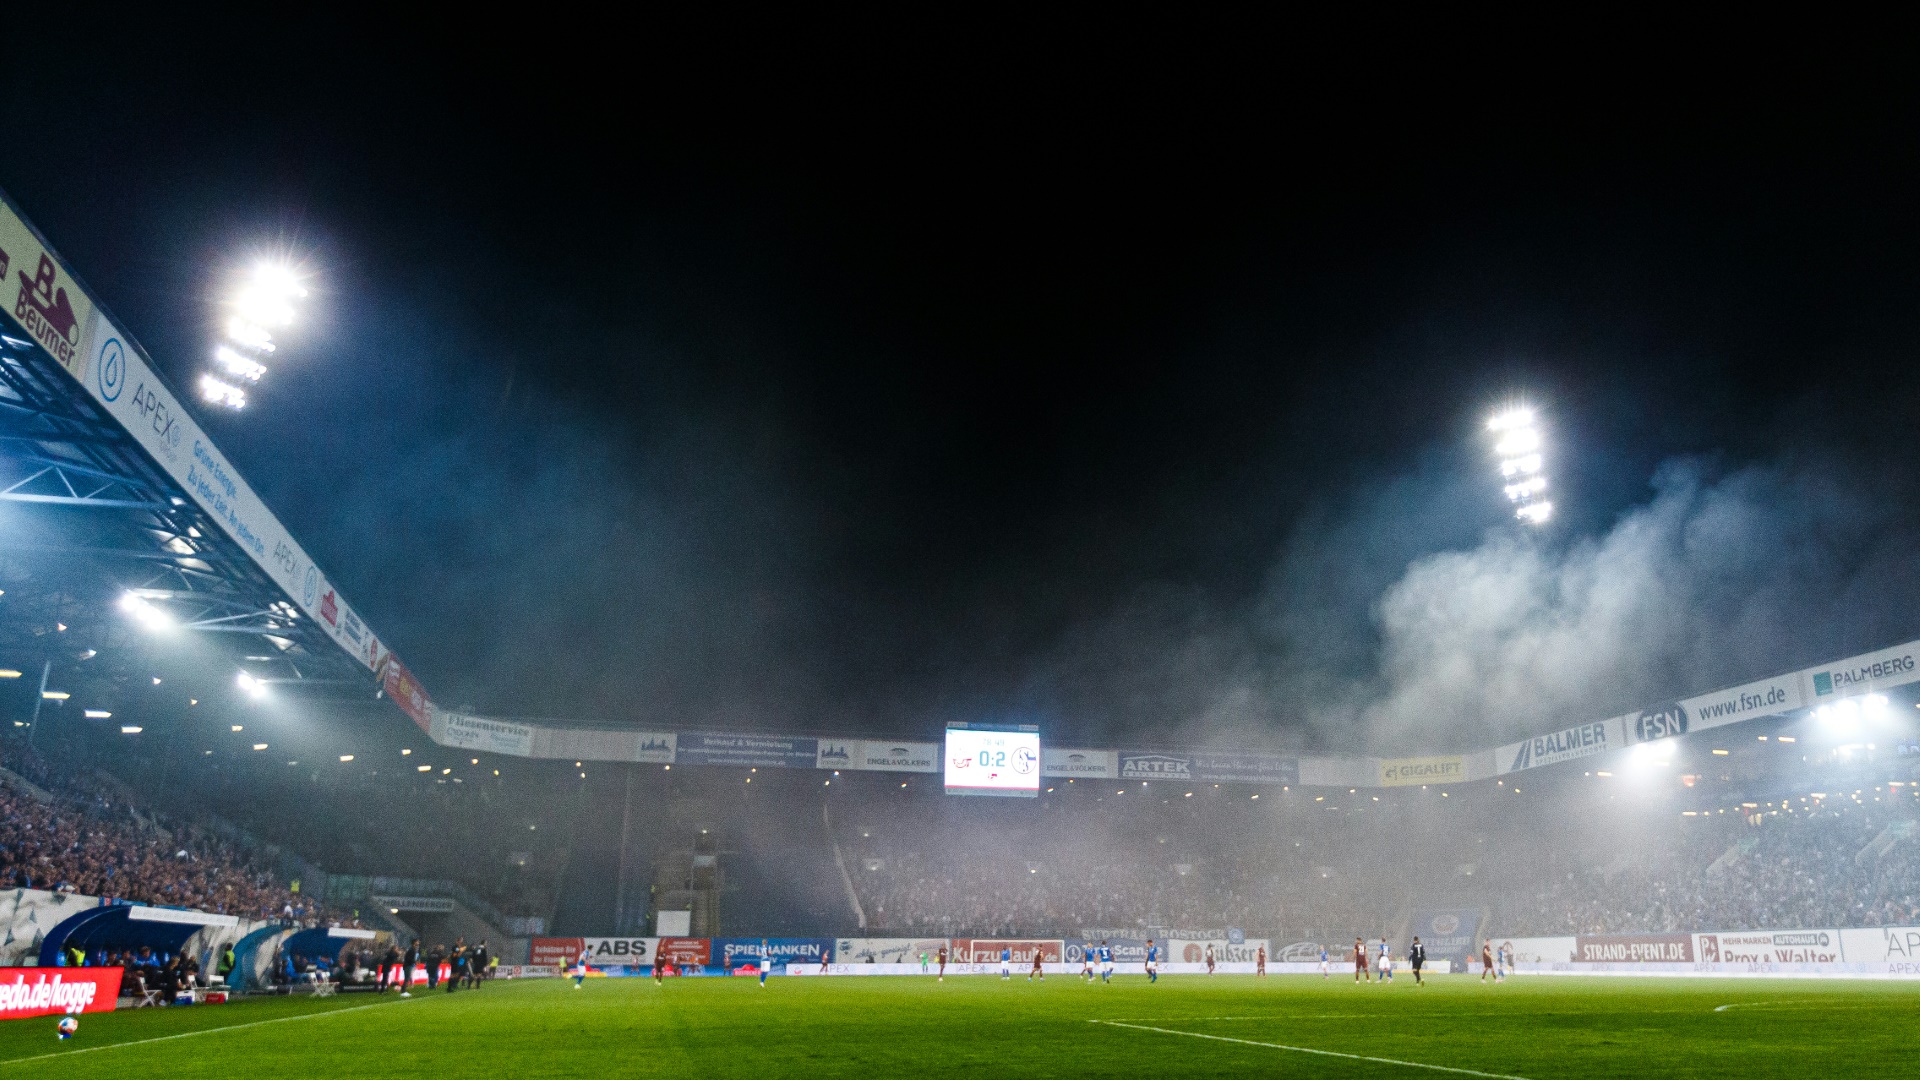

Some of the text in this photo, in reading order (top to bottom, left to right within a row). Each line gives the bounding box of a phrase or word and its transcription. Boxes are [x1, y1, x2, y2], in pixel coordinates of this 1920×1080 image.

[15, 286, 75, 367] Beumer
[132, 382, 175, 445] APEX
[273, 539, 298, 575] APEX
[1833, 655, 1915, 687] PALMBERG
[1699, 686, 1785, 721] www.fsn.de
[1643, 710, 1681, 740] FSN
[1533, 723, 1606, 757] BALMER
[979, 750, 1006, 767] 0:2
[1123, 760, 1190, 772] ARTEK
[1400, 762, 1461, 776] GIGALIFT
[1158, 929, 1226, 940] ROSTOCK
[1722, 937, 1742, 945] MEHR
[1742, 936, 1772, 945] MARKEN
[597, 940, 647, 955] ABS
[724, 943, 820, 956] SPIELANKEN
[1583, 942, 1686, 960] STRAND-EVENT.DE
[1775, 949, 1836, 963] Walter
[1888, 962, 1920, 974] APEX
